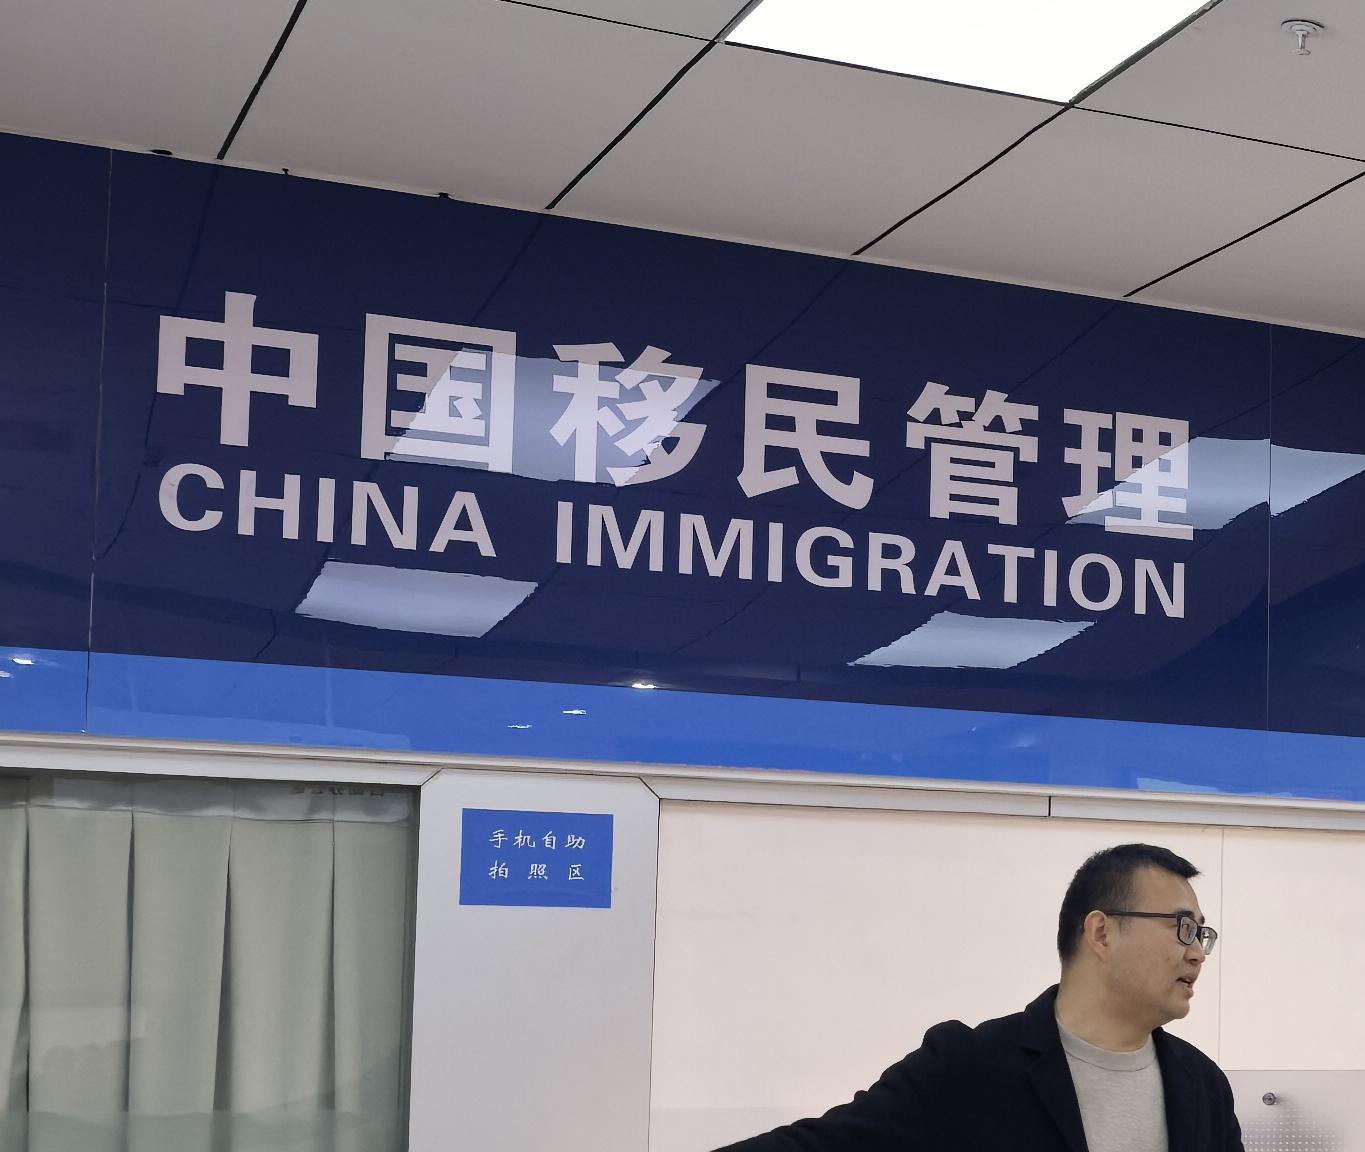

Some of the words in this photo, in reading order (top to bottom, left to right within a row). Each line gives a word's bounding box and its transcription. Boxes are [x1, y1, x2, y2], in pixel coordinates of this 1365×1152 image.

[155, 289, 1196, 541] 中国移民管理
[158, 461, 498, 559] CHINA
[555, 500, 1188, 620] IMMIGRATION
[488, 860, 585, 881] 拍照区
[489, 829, 586, 850] 手机自助
